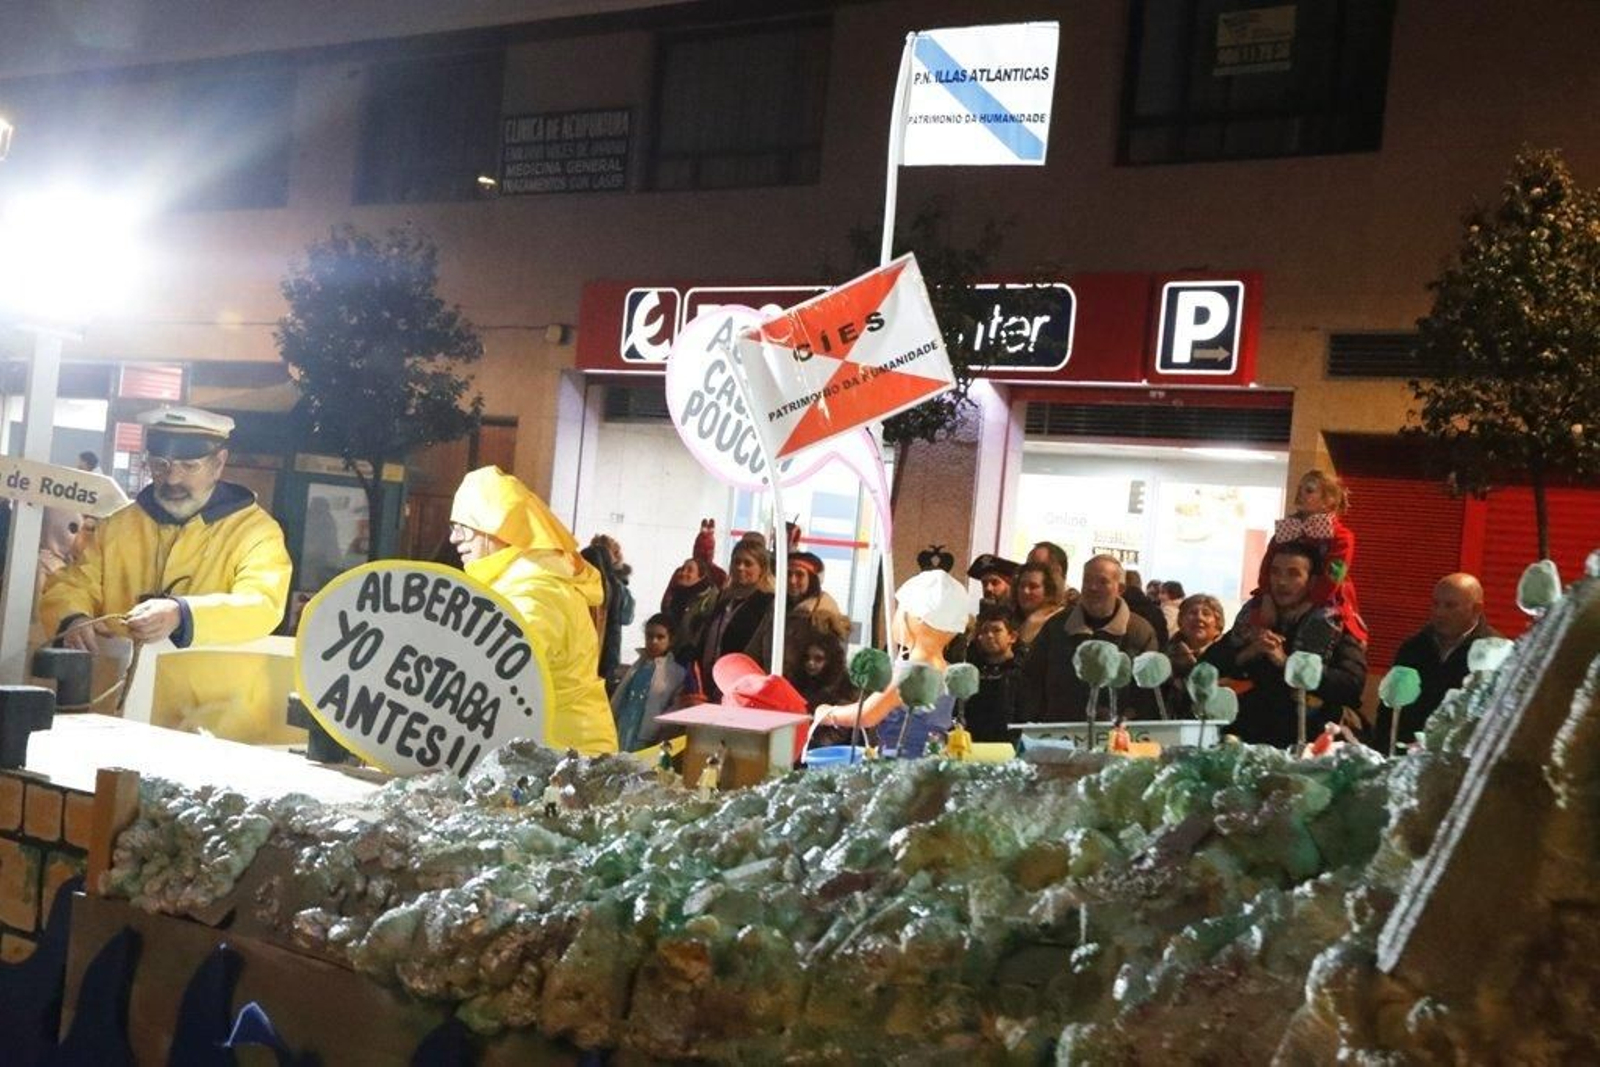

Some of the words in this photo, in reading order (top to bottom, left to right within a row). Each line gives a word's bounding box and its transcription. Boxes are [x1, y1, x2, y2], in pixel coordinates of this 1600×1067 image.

[914, 72, 931, 85] P.N.
[935, 69, 967, 84] ILLAS
[908, 114, 962, 125] PATRIMONIO
[965, 114, 976, 124] DA
[979, 113, 1046, 124] HUMANIDADE
[505, 161, 562, 177] MEDICINA
[566, 158, 624, 174] GENERAL
[1171, 290, 1230, 363] P
[842, 377, 861, 391] DA
[861, 340, 939, 383] HUMANIDADE
[7, 470, 30, 490] de
[39, 476, 98, 504] Rodas
[321, 610, 384, 671] YO
[385, 645, 500, 739] ESTABA
